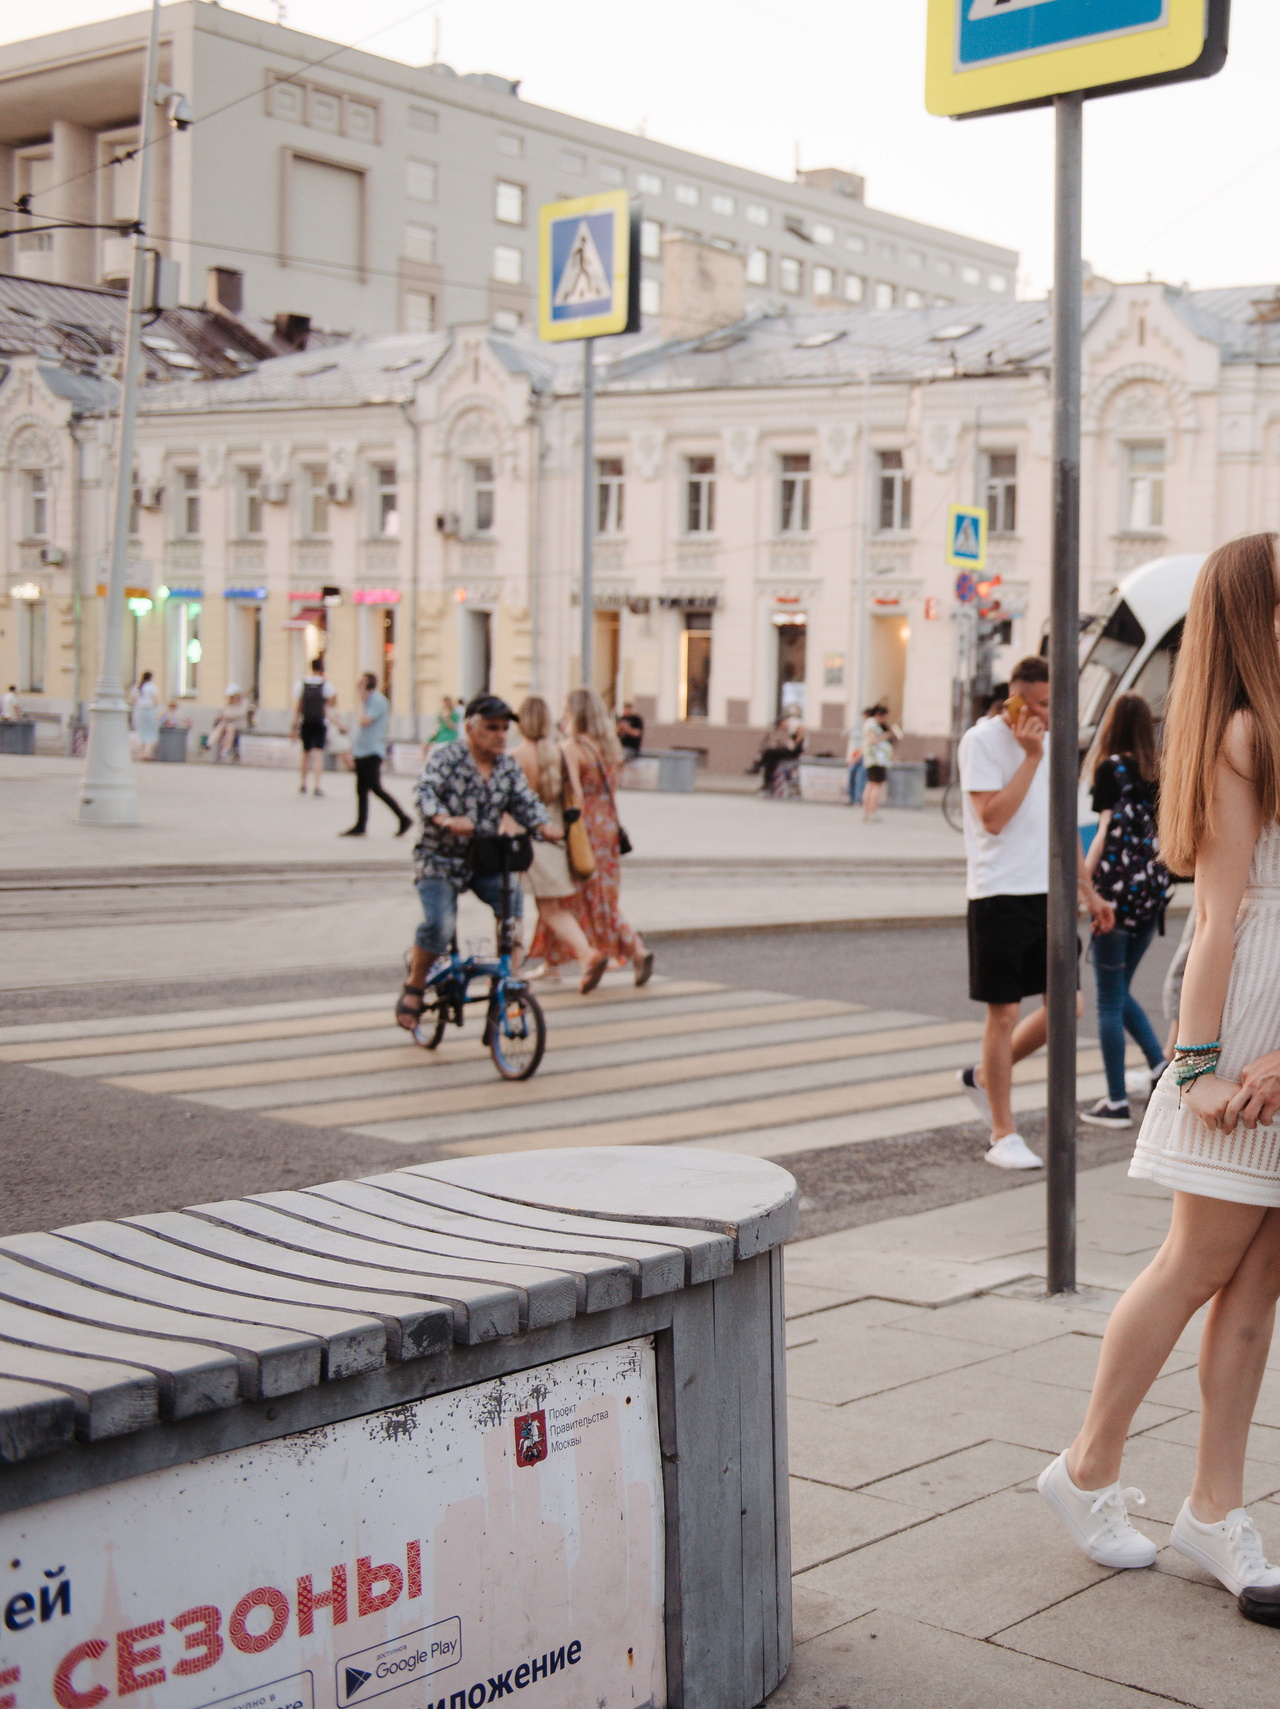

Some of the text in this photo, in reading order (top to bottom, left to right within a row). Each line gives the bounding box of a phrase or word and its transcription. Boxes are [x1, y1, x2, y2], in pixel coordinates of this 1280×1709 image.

[548, 1404, 577, 1420] Проект
[549, 1410, 609, 1437] Правительства
[551, 1436, 582, 1454] Москвы
[53, 1538, 424, 1709] СЕЗОНЫ
[376, 1638, 458, 1679] Google Play
